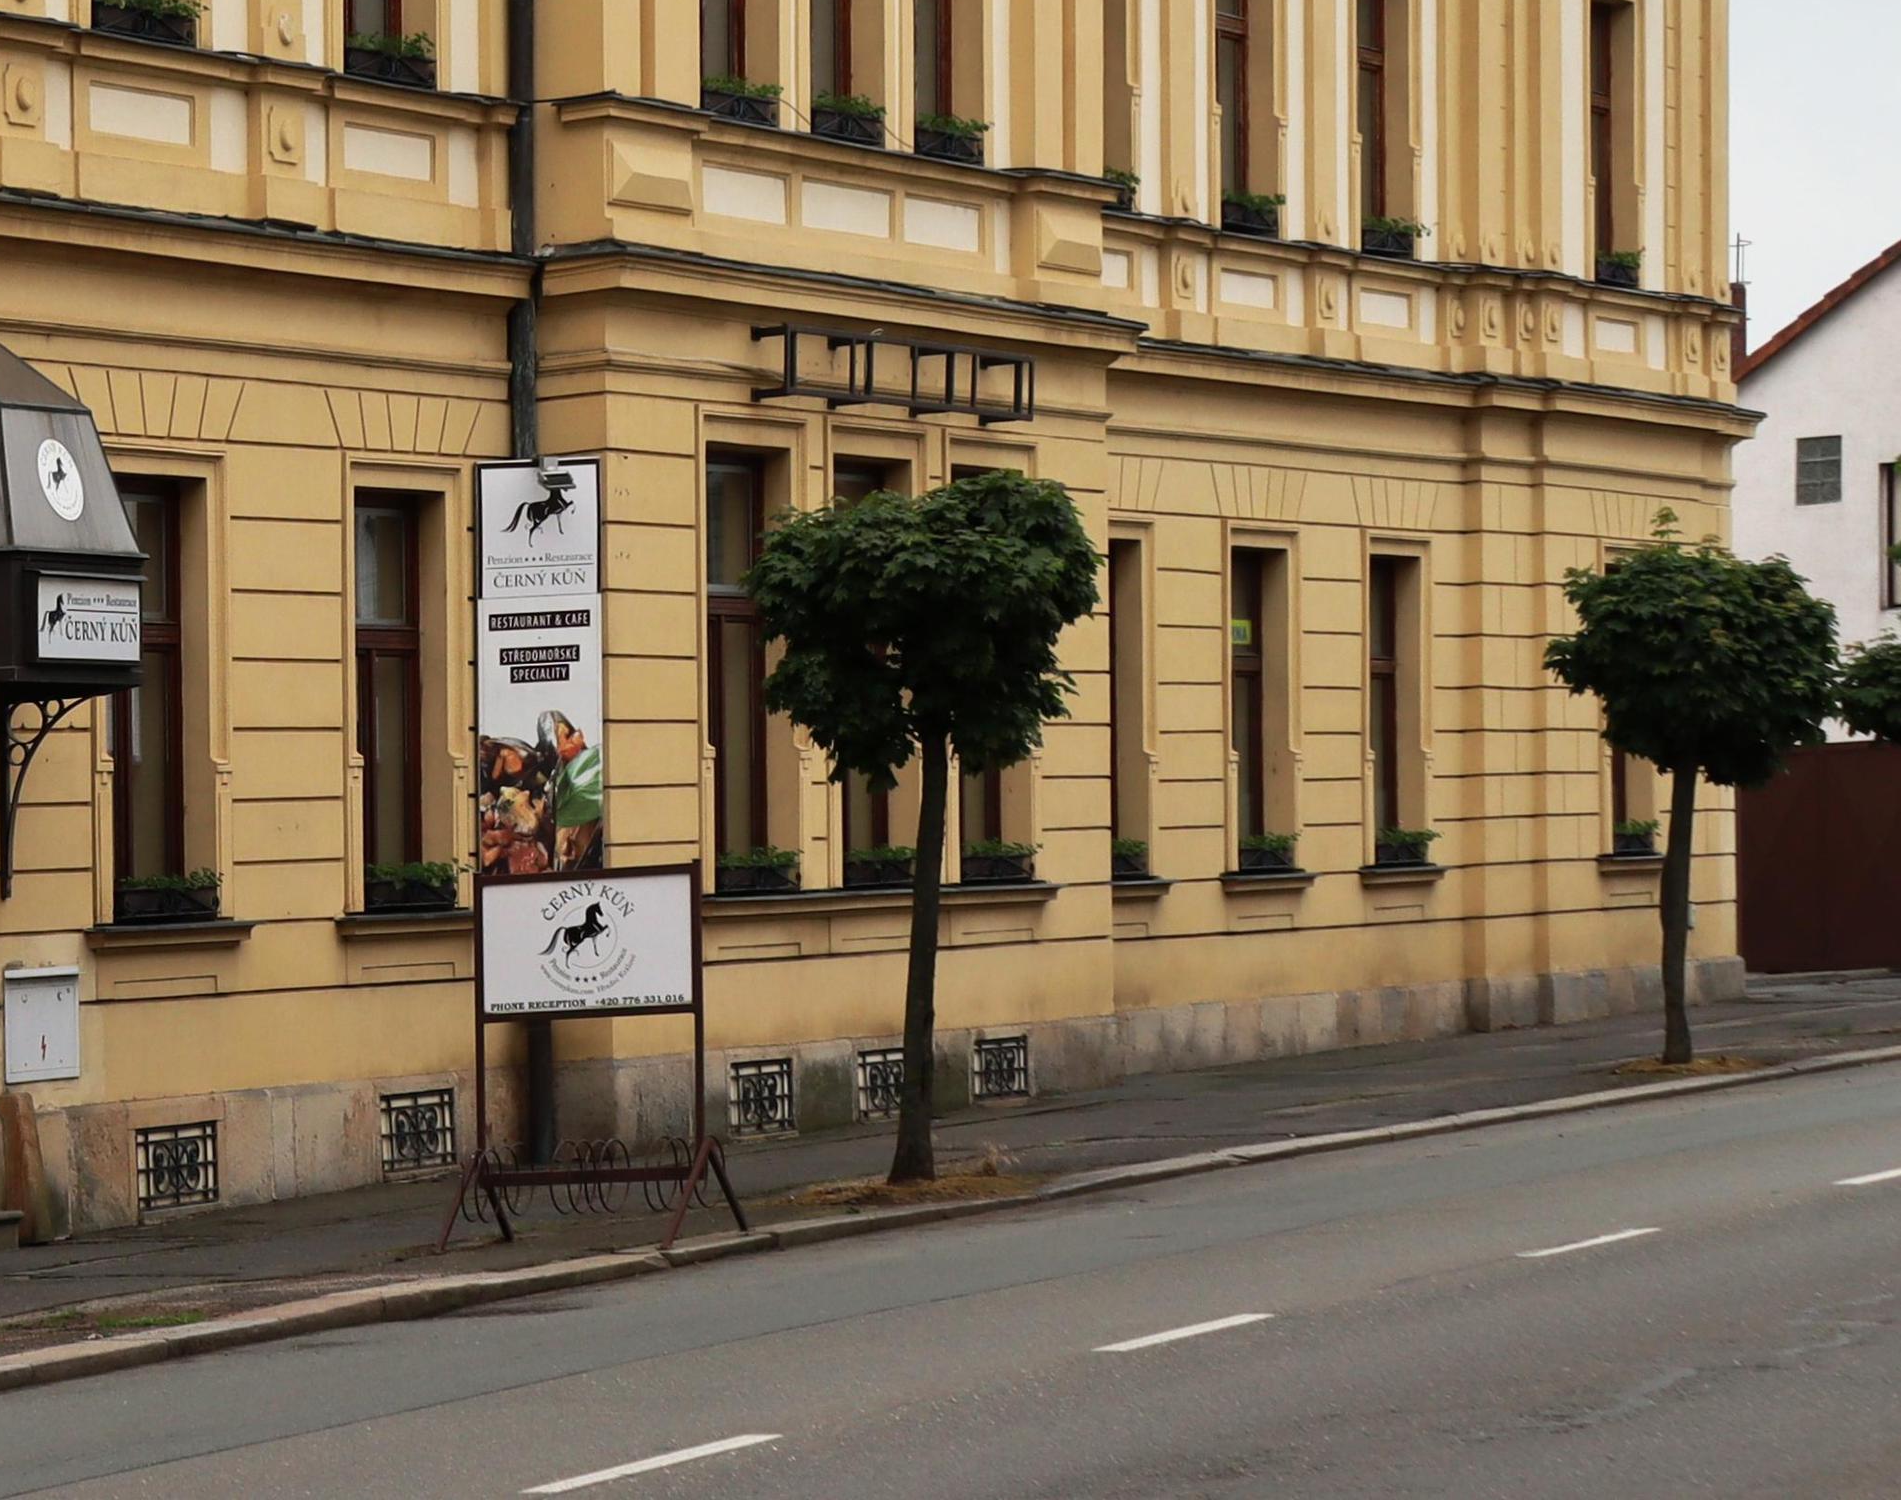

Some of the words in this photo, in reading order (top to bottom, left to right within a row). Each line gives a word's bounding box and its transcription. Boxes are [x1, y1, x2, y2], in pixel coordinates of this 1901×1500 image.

[493, 569, 547, 589] ČERNÝ
[551, 568, 586, 586] KŮŇ
[65, 615, 107, 642] ČERNÝ
[110, 617, 138, 643] KŮŇ
[491, 614, 552, 629] RESTAURANT
[554, 614, 562, 626] &
[502, 646, 577, 663] STŘEDOMOŘSKÉ
[513, 667, 567, 681] SPECIALITY
[541, 879, 595, 921] ČERNÝ
[490, 1002, 525, 1012] PHONE
[528, 999, 586, 1010] RECEPTION
[622, 996, 641, 1005] 776
[665, 994, 685, 1003] 016
